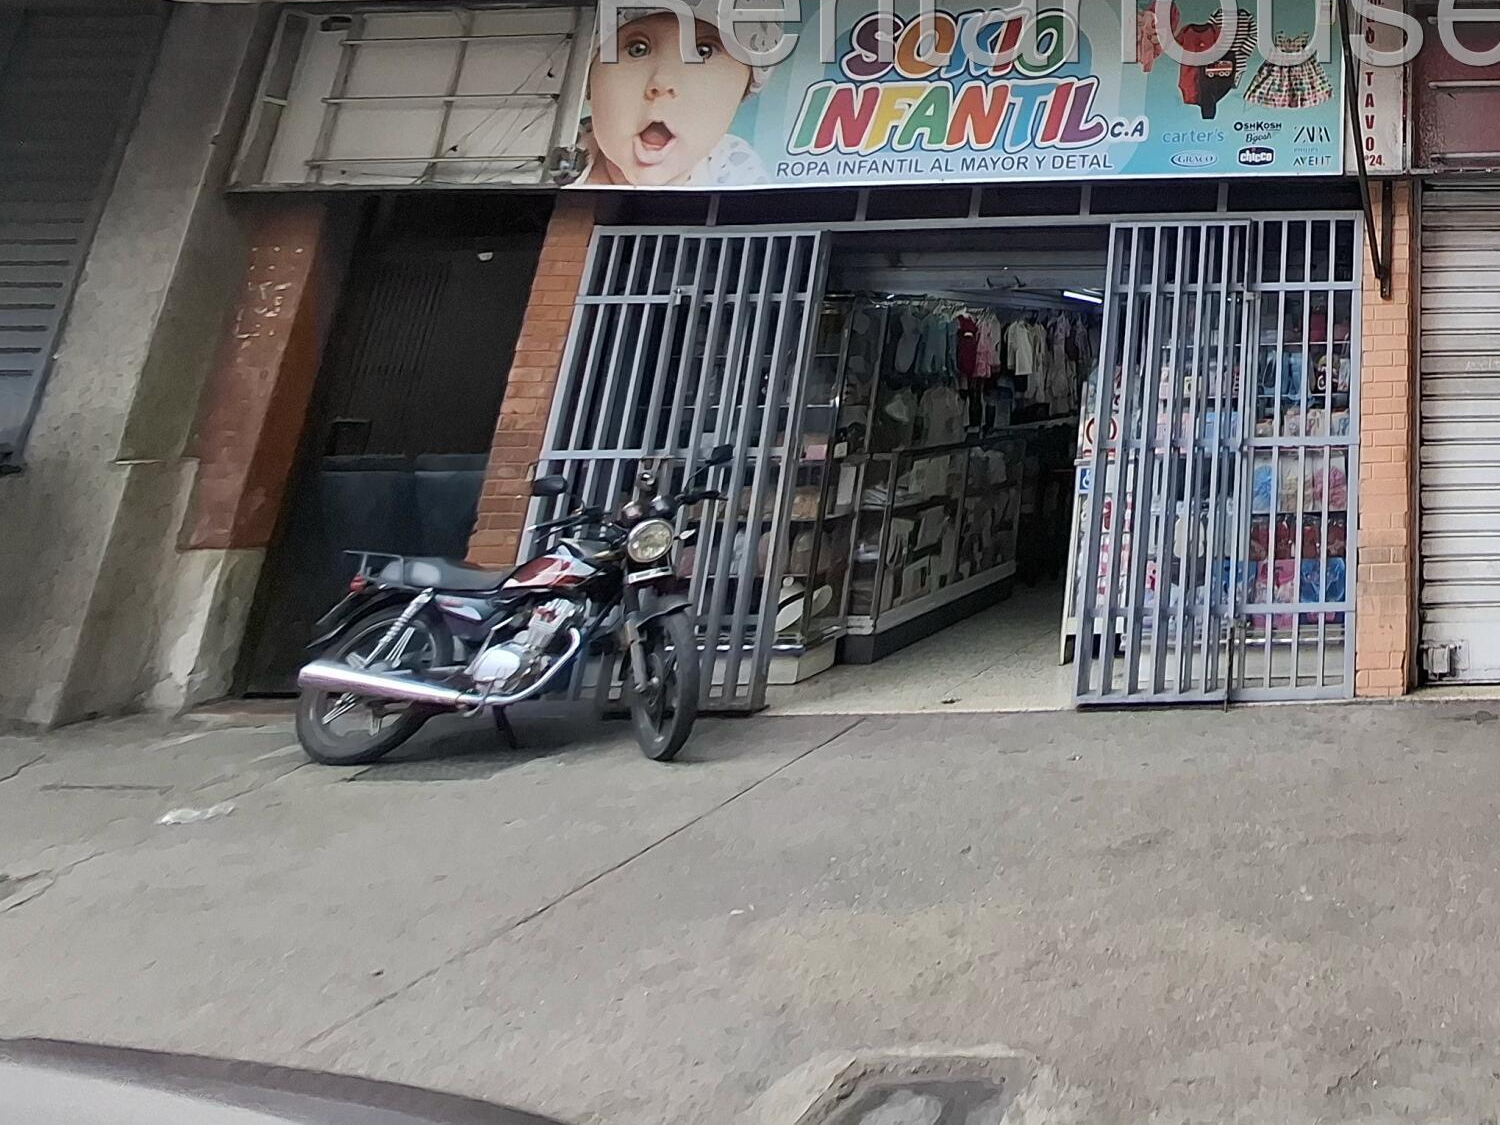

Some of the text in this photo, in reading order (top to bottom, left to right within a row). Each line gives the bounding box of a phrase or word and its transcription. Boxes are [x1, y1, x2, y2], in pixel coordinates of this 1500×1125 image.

[842, 8, 1079, 80] SOKIO
[786, 76, 1108, 155] INFANTIL
[1162, 129, 1225, 144] carter's
[776, 154, 1113, 177] ROPA INFANTIL AL MAYOR Y DETAL
[1239, 150, 1273, 164] chicco
